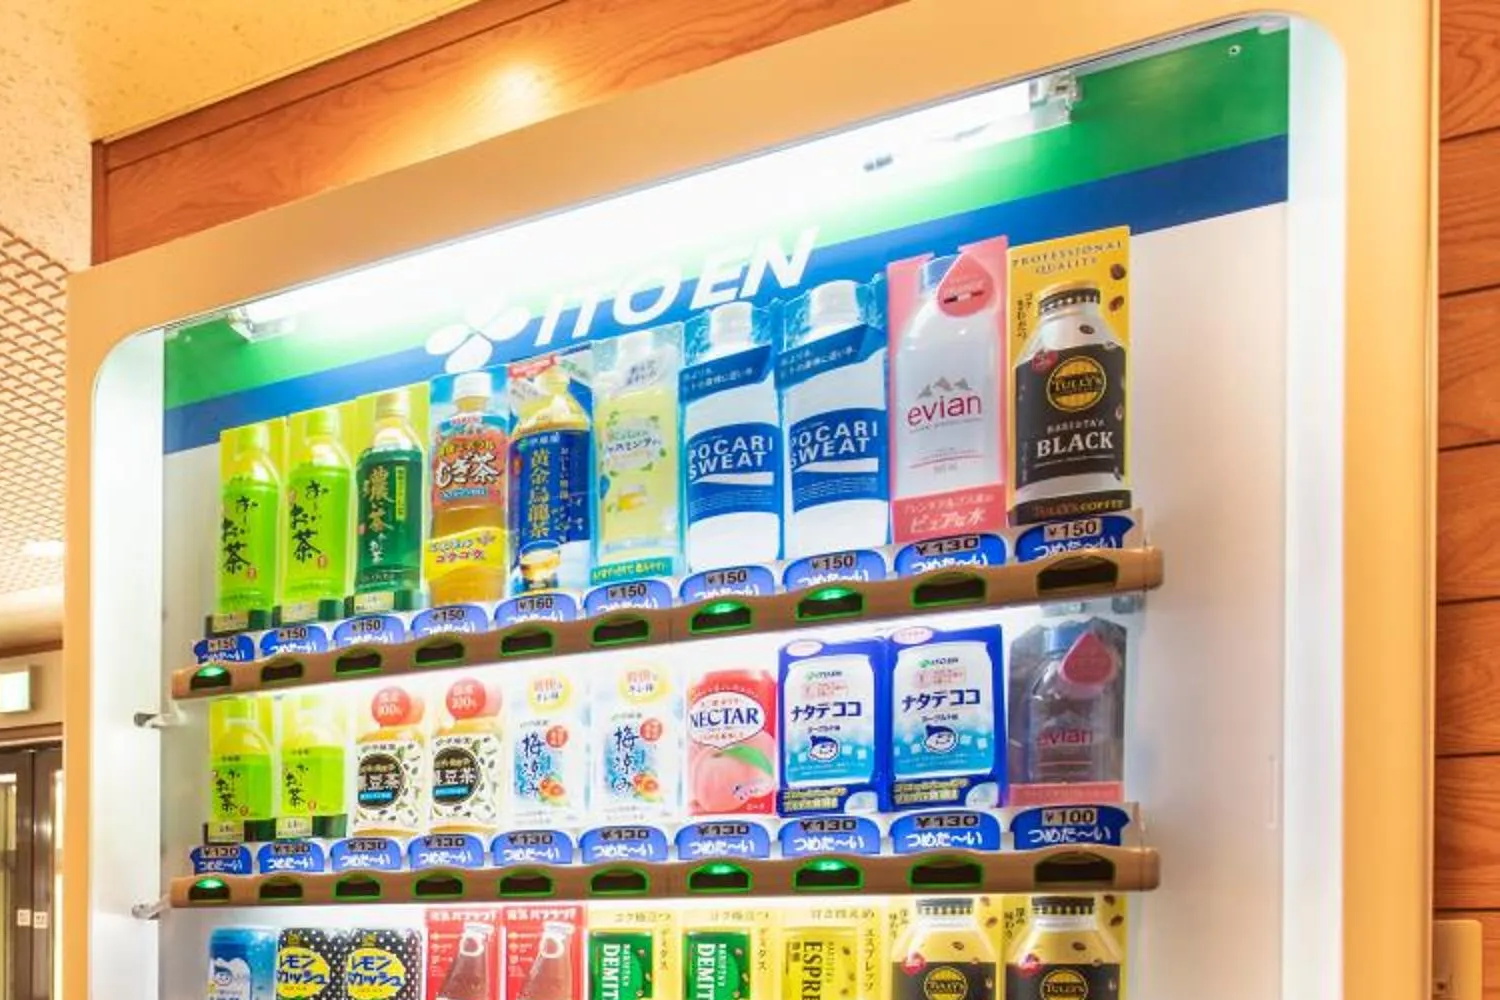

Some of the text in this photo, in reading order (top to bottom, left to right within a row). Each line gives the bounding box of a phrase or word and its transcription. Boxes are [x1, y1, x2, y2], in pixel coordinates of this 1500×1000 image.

[907, 394, 983, 426] evian
[789, 420, 878, 448] POCARI
[1037, 431, 1114, 458] BLACK
[689, 435, 773, 461] POCARI
[789, 438, 870, 469] SWEAT
[435, 450, 501, 488] むぎ茶
[689, 451, 767, 481] SWEAT
[1049, 520, 1097, 537] ¥150
[812, 555, 854, 569] ¥150
[707, 570, 748, 585] ¥150
[609, 584, 647, 598] ¥150
[791, 701, 862, 722] ナタデココ
[902, 689, 981, 713] ナタデココ
[690, 707, 760, 729] NECTAR
[801, 819, 857, 832] ¥130
[916, 815, 979, 828] ¥130
[1044, 810, 1094, 824] ¥100
